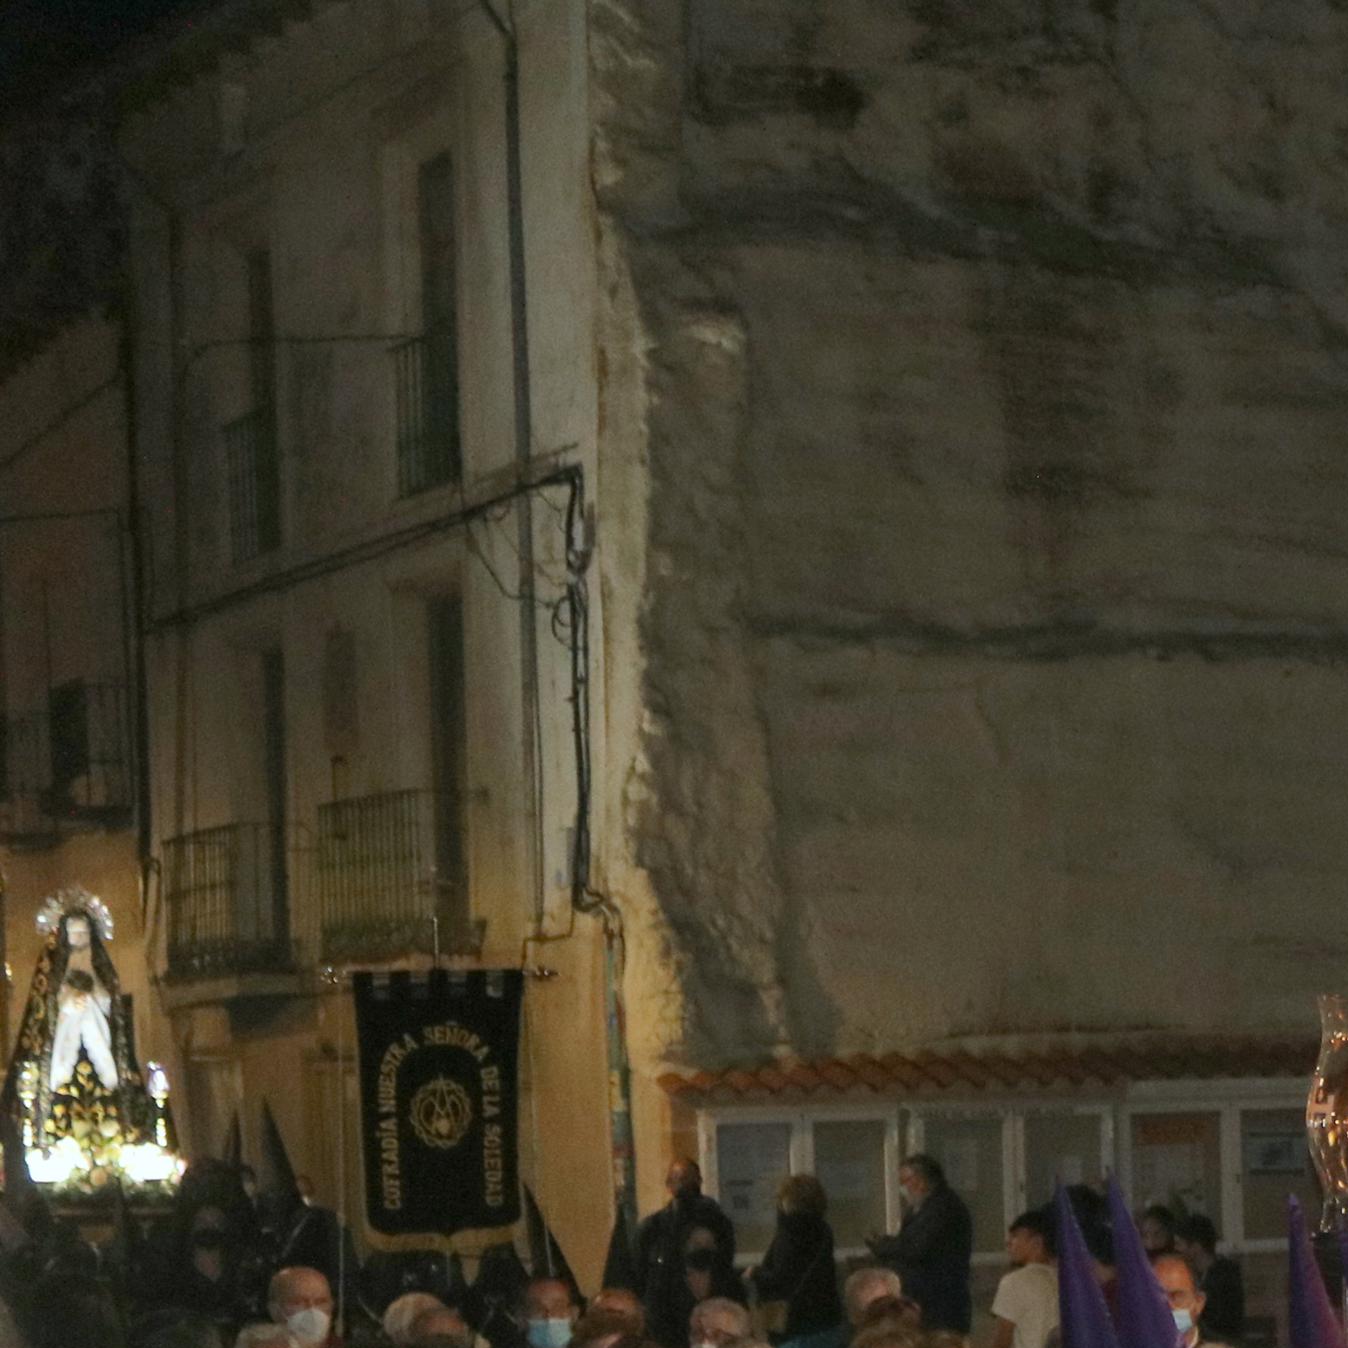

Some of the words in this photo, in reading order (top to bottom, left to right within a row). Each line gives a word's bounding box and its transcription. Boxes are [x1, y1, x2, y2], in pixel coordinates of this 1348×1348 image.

[423, 1021, 490, 1063] SEÑORA
[378, 1033, 419, 1113] NUESTRA
[480, 1066, 500, 1090] DE
[482, 1094, 501, 1118] LA
[377, 1116, 402, 1210] COFRADÍA
[483, 1124, 504, 1206] SOLEDAD
